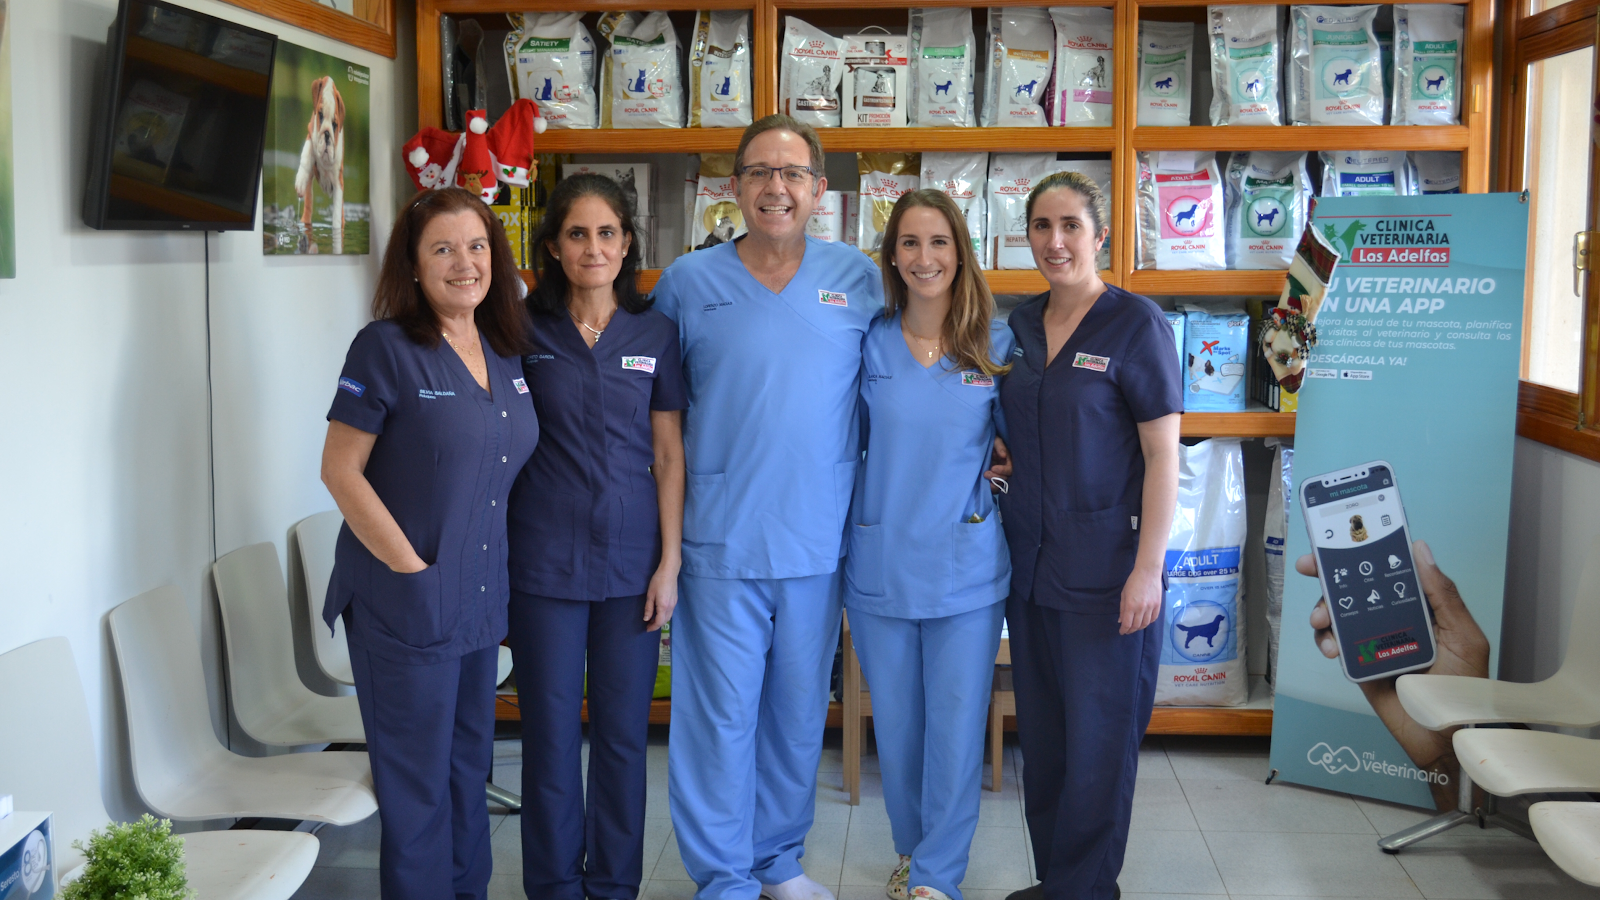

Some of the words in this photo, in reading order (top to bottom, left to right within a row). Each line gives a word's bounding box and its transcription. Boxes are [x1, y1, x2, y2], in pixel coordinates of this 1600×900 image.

[1316, 15, 1359, 24] PEDIATRIC
[1067, 40, 1086, 48] ROYAL
[819, 48, 838, 56] CANIN
[857, 114, 869, 122] KIT
[1345, 156, 1389, 164] NEUTERED
[1376, 219, 1435, 232] CLINICA
[1360, 233, 1450, 245] VETERINARIA
[1359, 249, 1383, 262] Las
[1387, 249, 1447, 263] Adelfas
[1328, 277, 1340, 293] U
[1346, 277, 1496, 294] VETERINARIO
[1345, 297, 1391, 313] UNA
[1396, 298, 1445, 314] APP
[1344, 317, 1353, 326] la
[1356, 318, 1384, 327] salud
[1386, 318, 1399, 327] de
[1402, 319, 1413, 327] tu
[1416, 320, 1462, 329] mascota,
[1465, 320, 1512, 330] planifica
[1328, 328, 1357, 336] visitas
[1362, 328, 1372, 337] al
[1377, 329, 1430, 339] veterinario
[1434, 332, 1442, 340] y
[1446, 331, 1491, 340] consulta
[1496, 332, 1511, 340] los
[1336, 338, 1371, 347] clínicos
[1373, 339, 1386, 347] de
[1388, 340, 1403, 348] tus
[1405, 341, 1456, 350] mascotas.
[1388, 356, 1407, 366] YA!
[1329, 490, 1339, 498] mi
[1340, 483, 1368, 495] mascota
[1183, 554, 1219, 567] ADULT
[1378, 650, 1390, 658] Las
[1391, 643, 1418, 655] Adelfas
[1173, 673, 1199, 682] ROYAL
[1201, 671, 1226, 681] CANIN
[1362, 751, 1375, 760] mi
[1362, 759, 1449, 785] veterinario
[1, 870, 20, 891] Seresto
